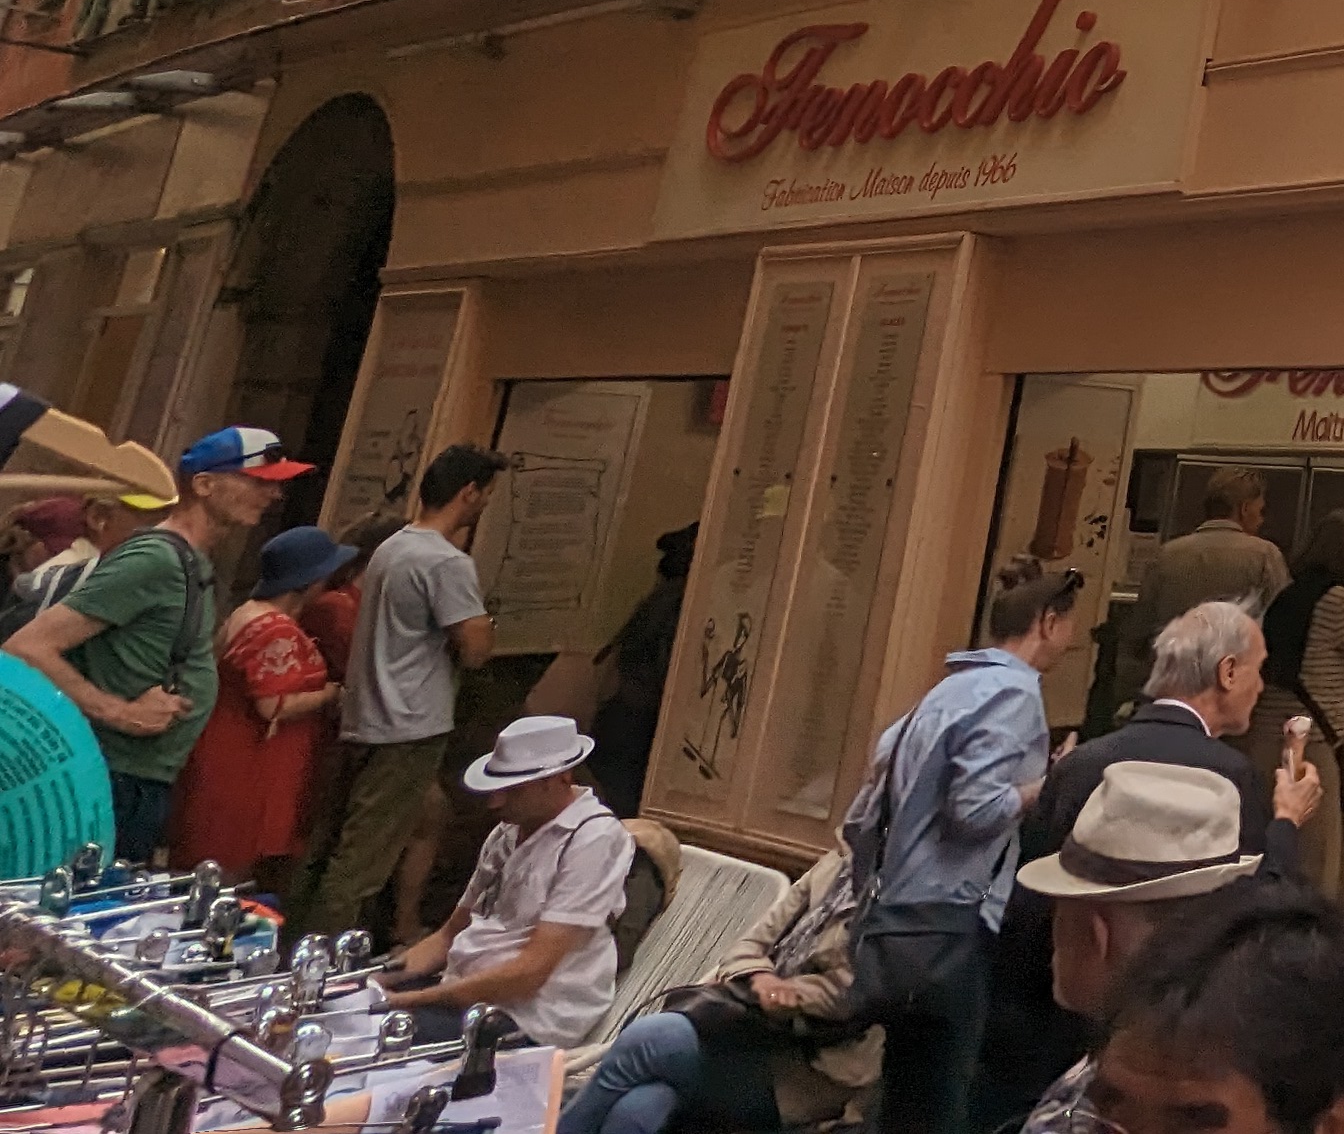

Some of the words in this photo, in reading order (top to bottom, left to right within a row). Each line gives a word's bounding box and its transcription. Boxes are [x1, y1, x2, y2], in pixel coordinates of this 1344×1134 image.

[761, 177, 846, 211] Fabrication
[849, 166, 916, 201] Maison
[918, 161, 972, 202] depuis
[974, 151, 1019, 187] 1966
